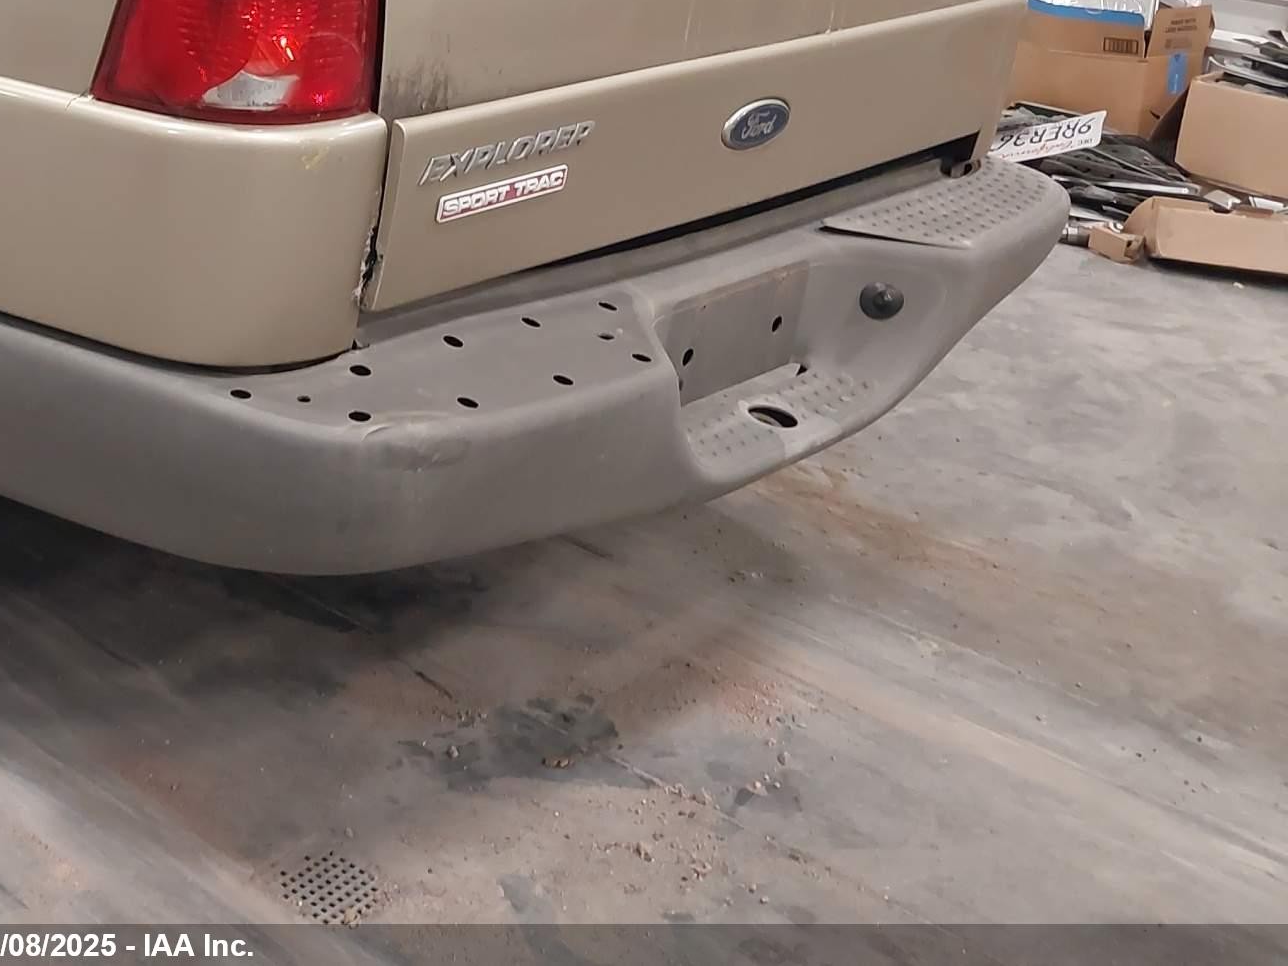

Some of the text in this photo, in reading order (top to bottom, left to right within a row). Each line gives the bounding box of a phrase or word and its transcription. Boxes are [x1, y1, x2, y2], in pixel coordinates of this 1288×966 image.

[740, 110, 778, 140] Ford
[418, 120, 597, 186] EXPLORER
[441, 170, 565, 217] SPORT TRAC
